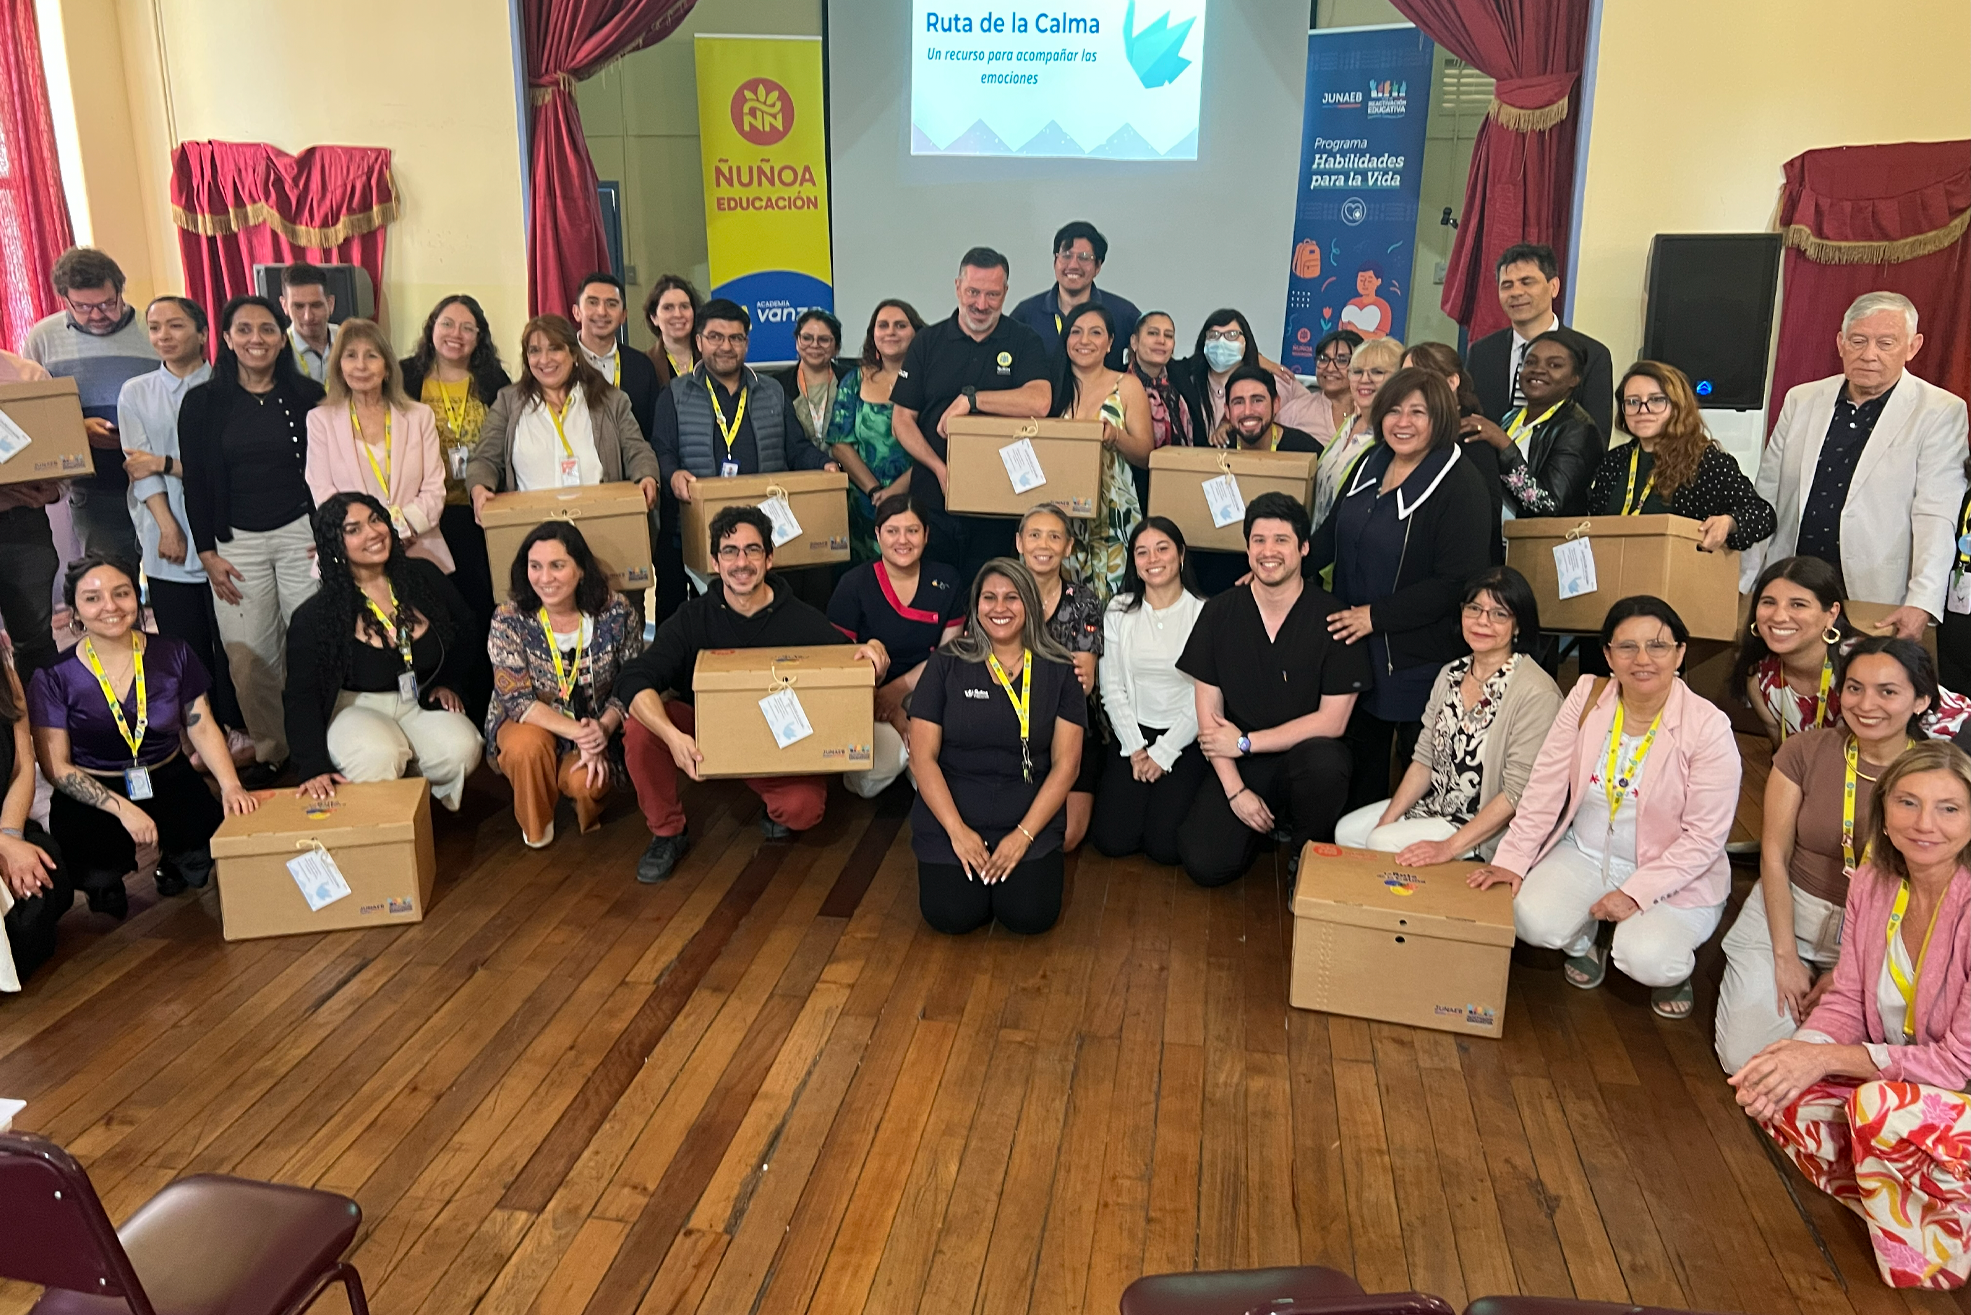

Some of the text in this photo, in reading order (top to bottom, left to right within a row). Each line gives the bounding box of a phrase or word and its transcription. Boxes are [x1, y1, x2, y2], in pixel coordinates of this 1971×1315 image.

[926, 12, 1100, 34] Ruta de la Calma
[927, 48, 1097, 65] Un recurso para acompañar las
[981, 71, 1038, 85] emociones
[1322, 92, 1362, 104] JUNAEB
[1367, 106, 1405, 114] EDUCATIVA
[1314, 137, 1368, 152] Programa
[1312, 153, 1405, 169] Habilidades
[714, 158, 817, 188] ÑUÑOA
[1310, 171, 1400, 190] para la Vida
[716, 190, 819, 212] EDUCACIÓN
[756, 300, 790, 308] ACADEMIA
